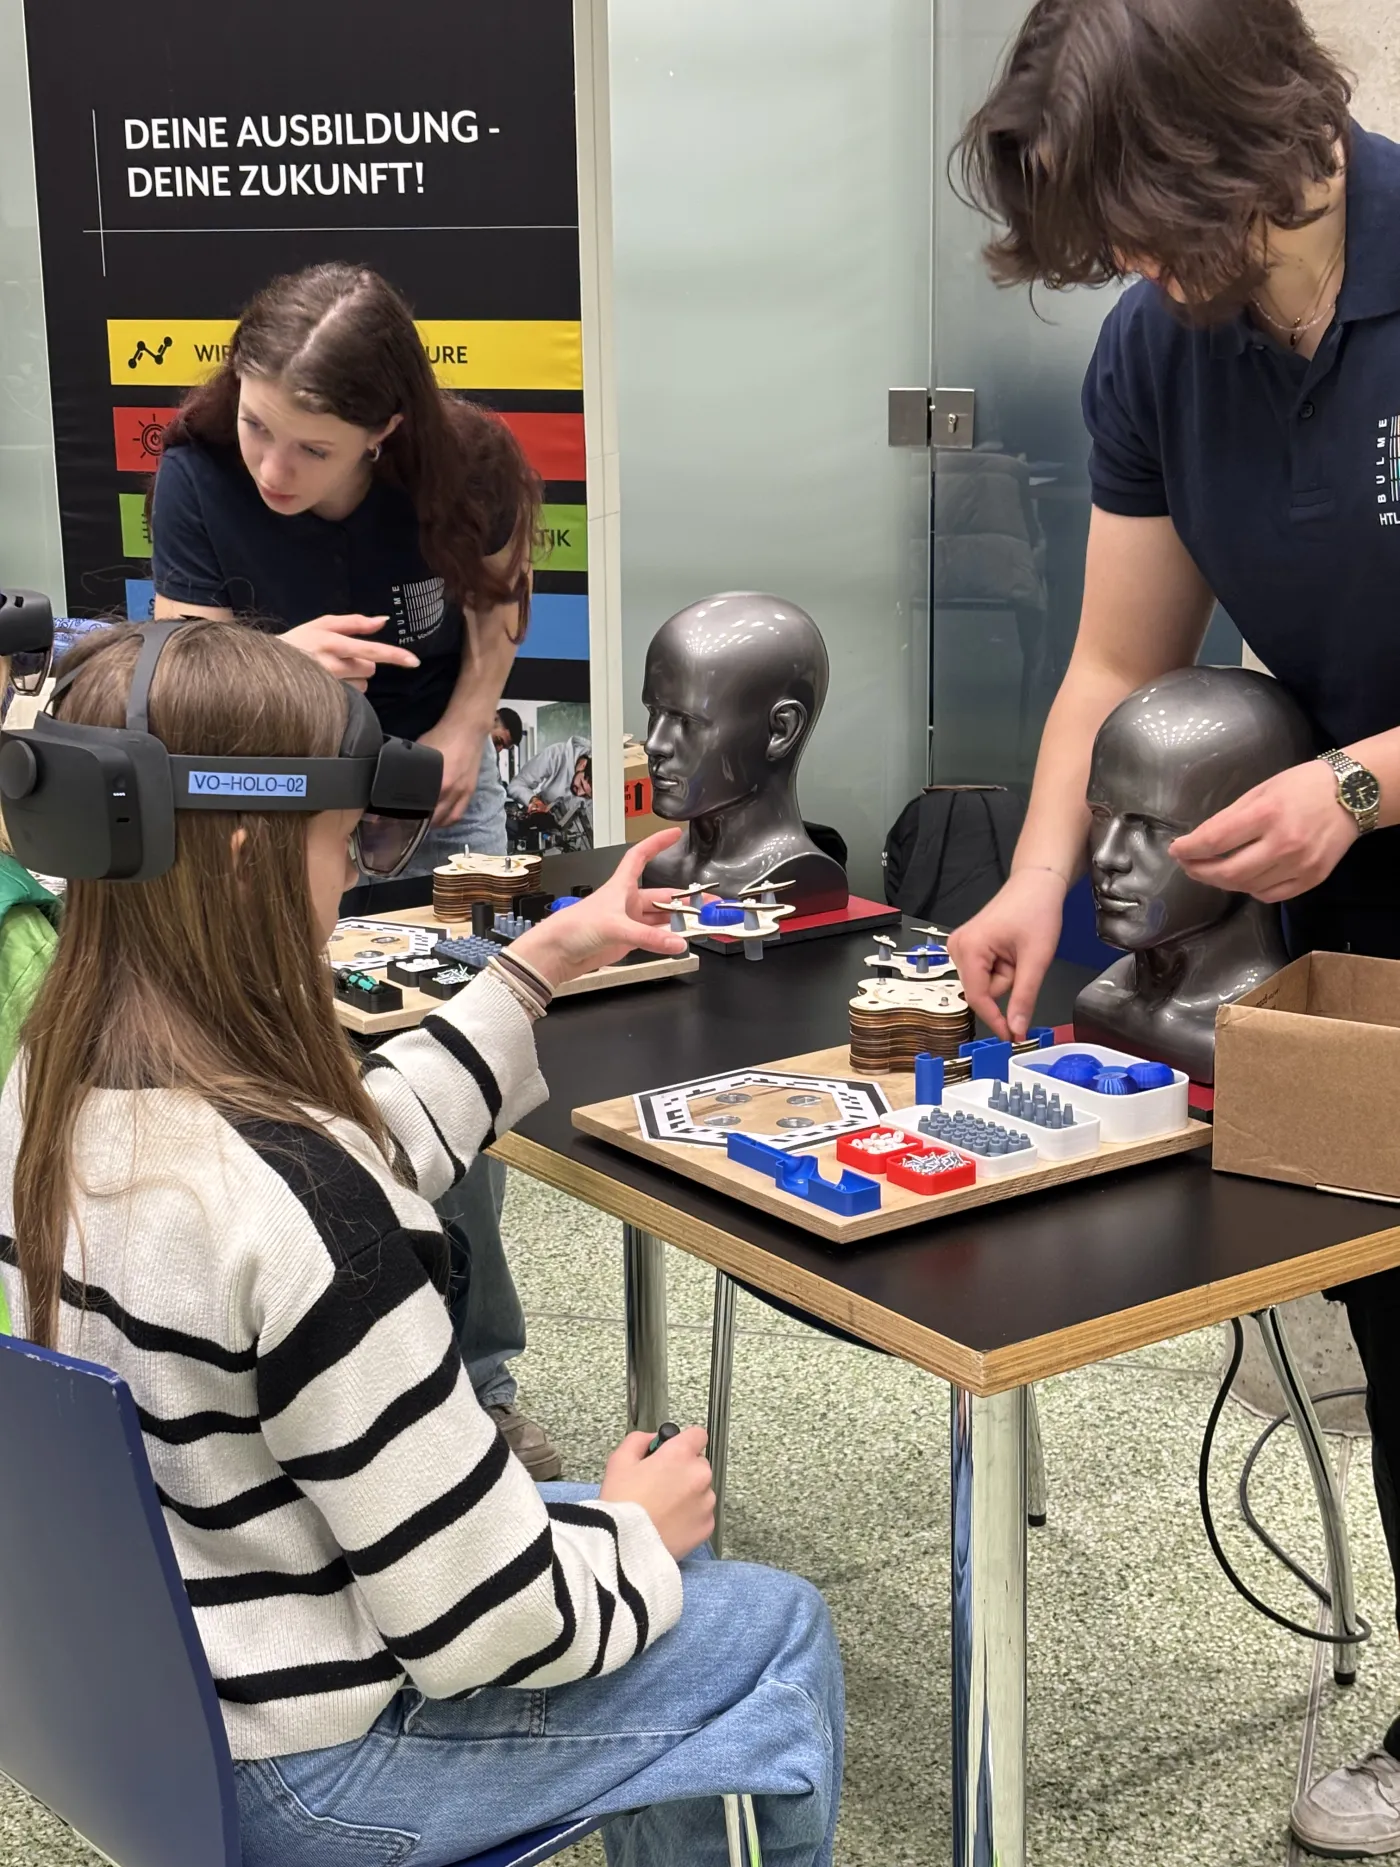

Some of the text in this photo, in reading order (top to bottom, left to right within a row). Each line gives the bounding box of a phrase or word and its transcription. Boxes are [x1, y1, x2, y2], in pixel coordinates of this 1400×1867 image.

[124, 116, 229, 150] DEINE
[236, 109, 479, 148] AUSBILDUNG
[127, 161, 424, 198] DEINE ZUKUNFT!
[1376, 418, 1387, 504] BULME
[1379, 512, 1400, 525] HTL
[392, 585, 406, 635] BULME
[193, 773, 304, 793] VO-HOLO-02
